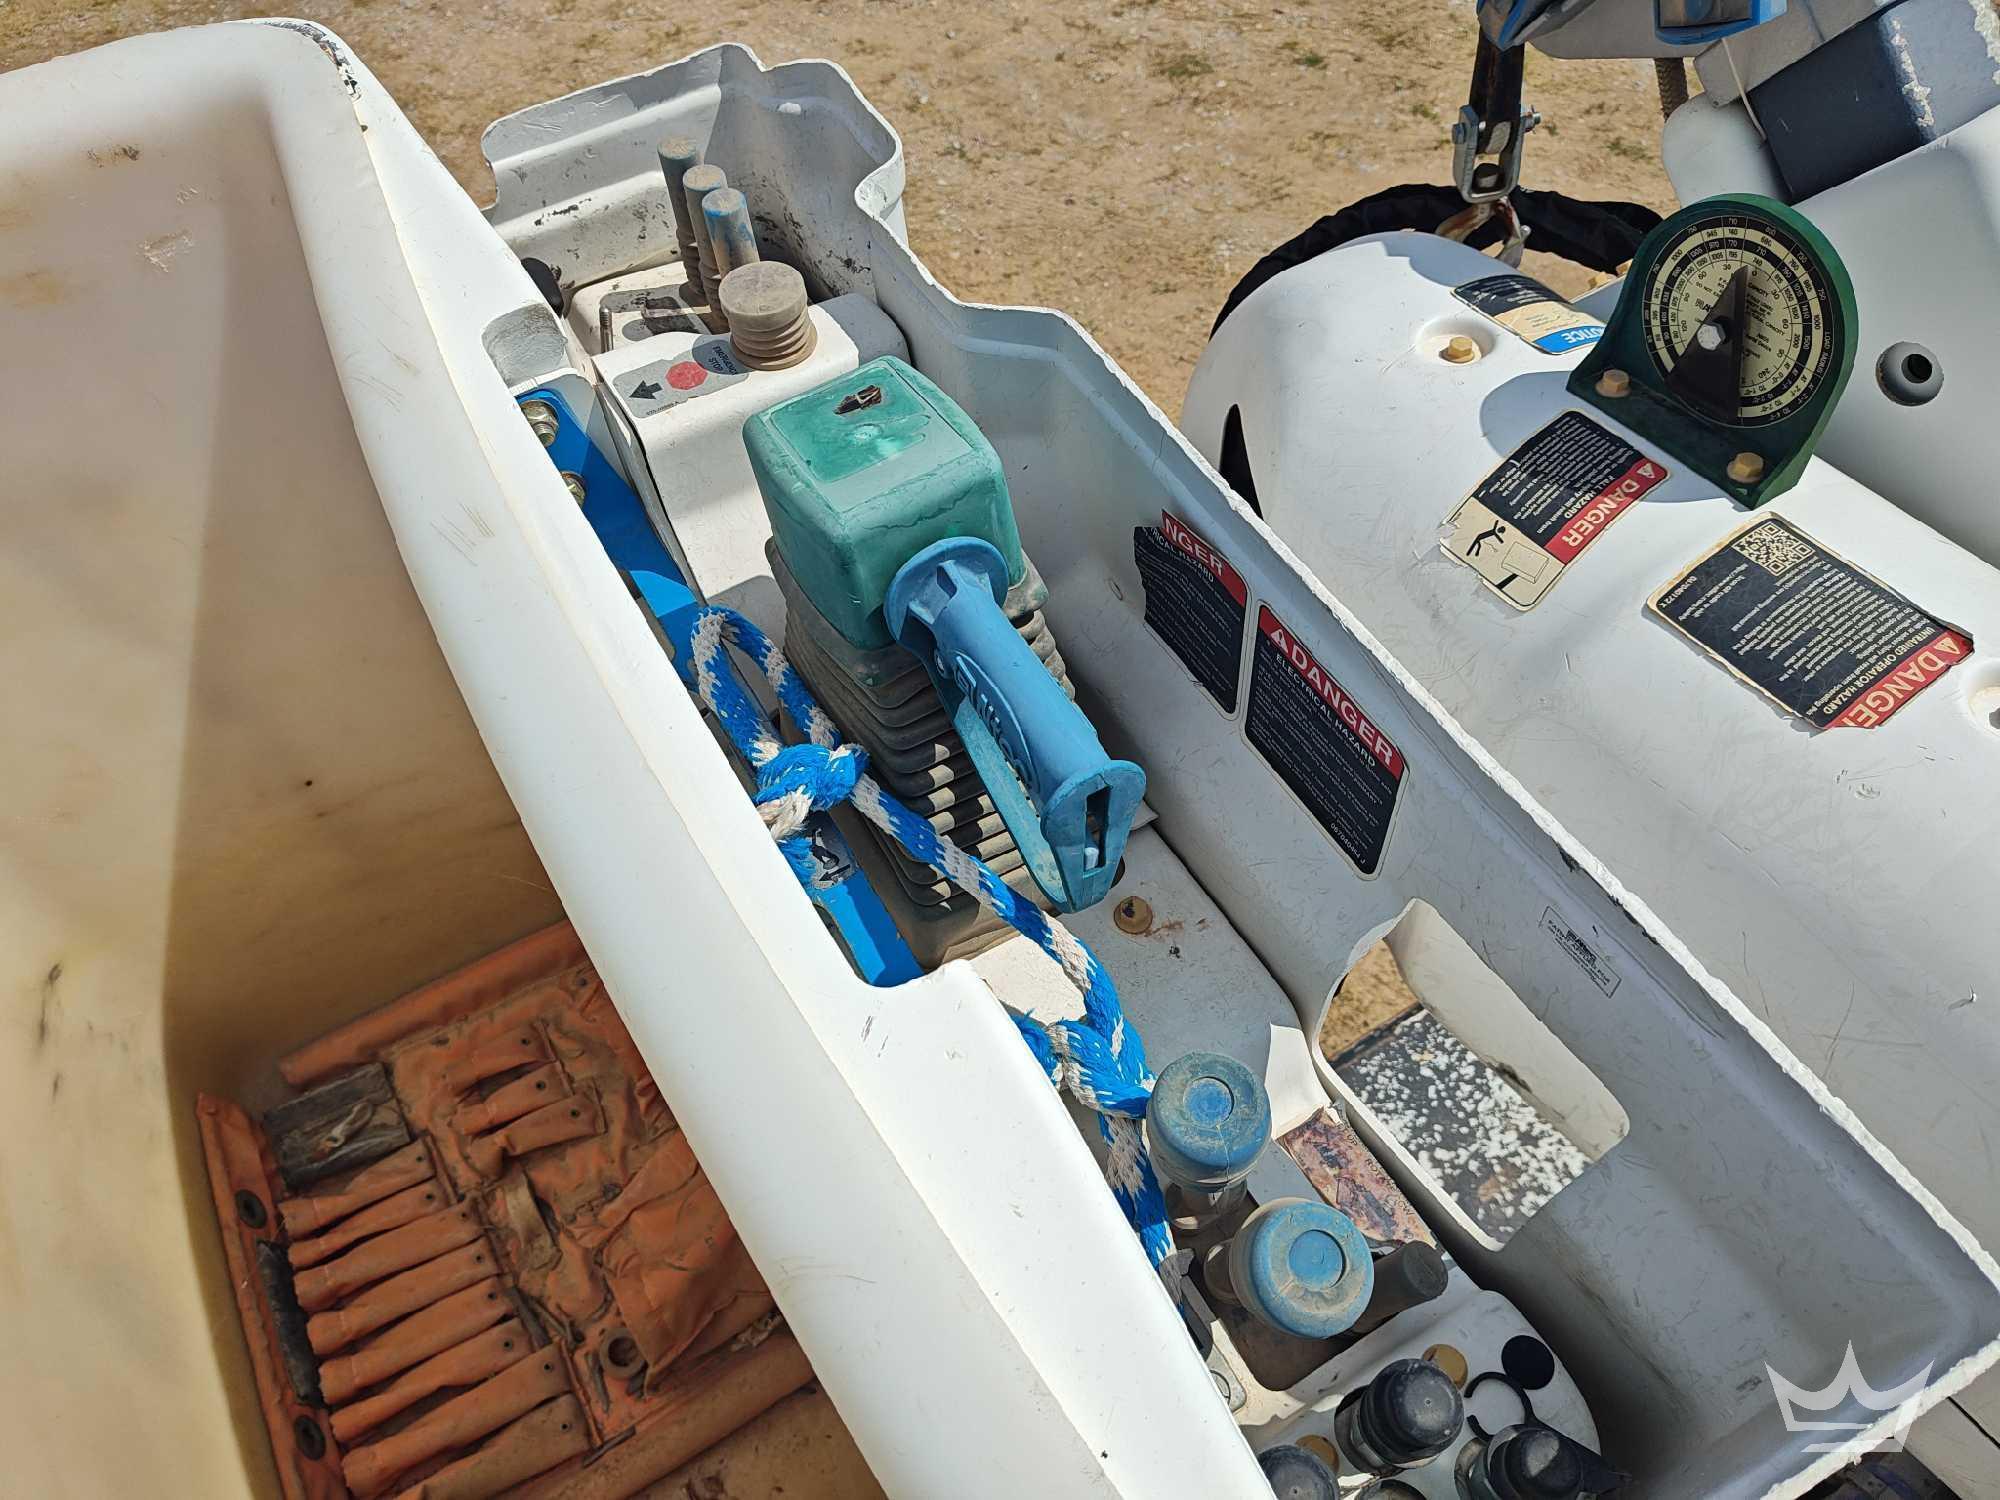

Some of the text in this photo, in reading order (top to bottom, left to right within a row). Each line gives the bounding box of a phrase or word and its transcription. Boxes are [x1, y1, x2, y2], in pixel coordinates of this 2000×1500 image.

[1771, 288, 1780, 300] 30
[1818, 287, 1826, 301] 750
[1782, 318, 1789, 329] 60
[1792, 334, 1801, 349] 2000
[1561, 474, 1615, 518] FALL HAZARD
[1535, 520, 1552, 533] from
[1557, 478, 1641, 547] DANGER
[1164, 517, 1222, 576] NGER
[1820, 625, 1936, 715] UNTRAINED OPERATOR HAZARD
[1866, 654, 1880, 663] will
[1276, 652, 1333, 722] ELECTRICAL
[1334, 718, 1376, 769] HAZARD
[1290, 642, 1393, 767] DANGER
